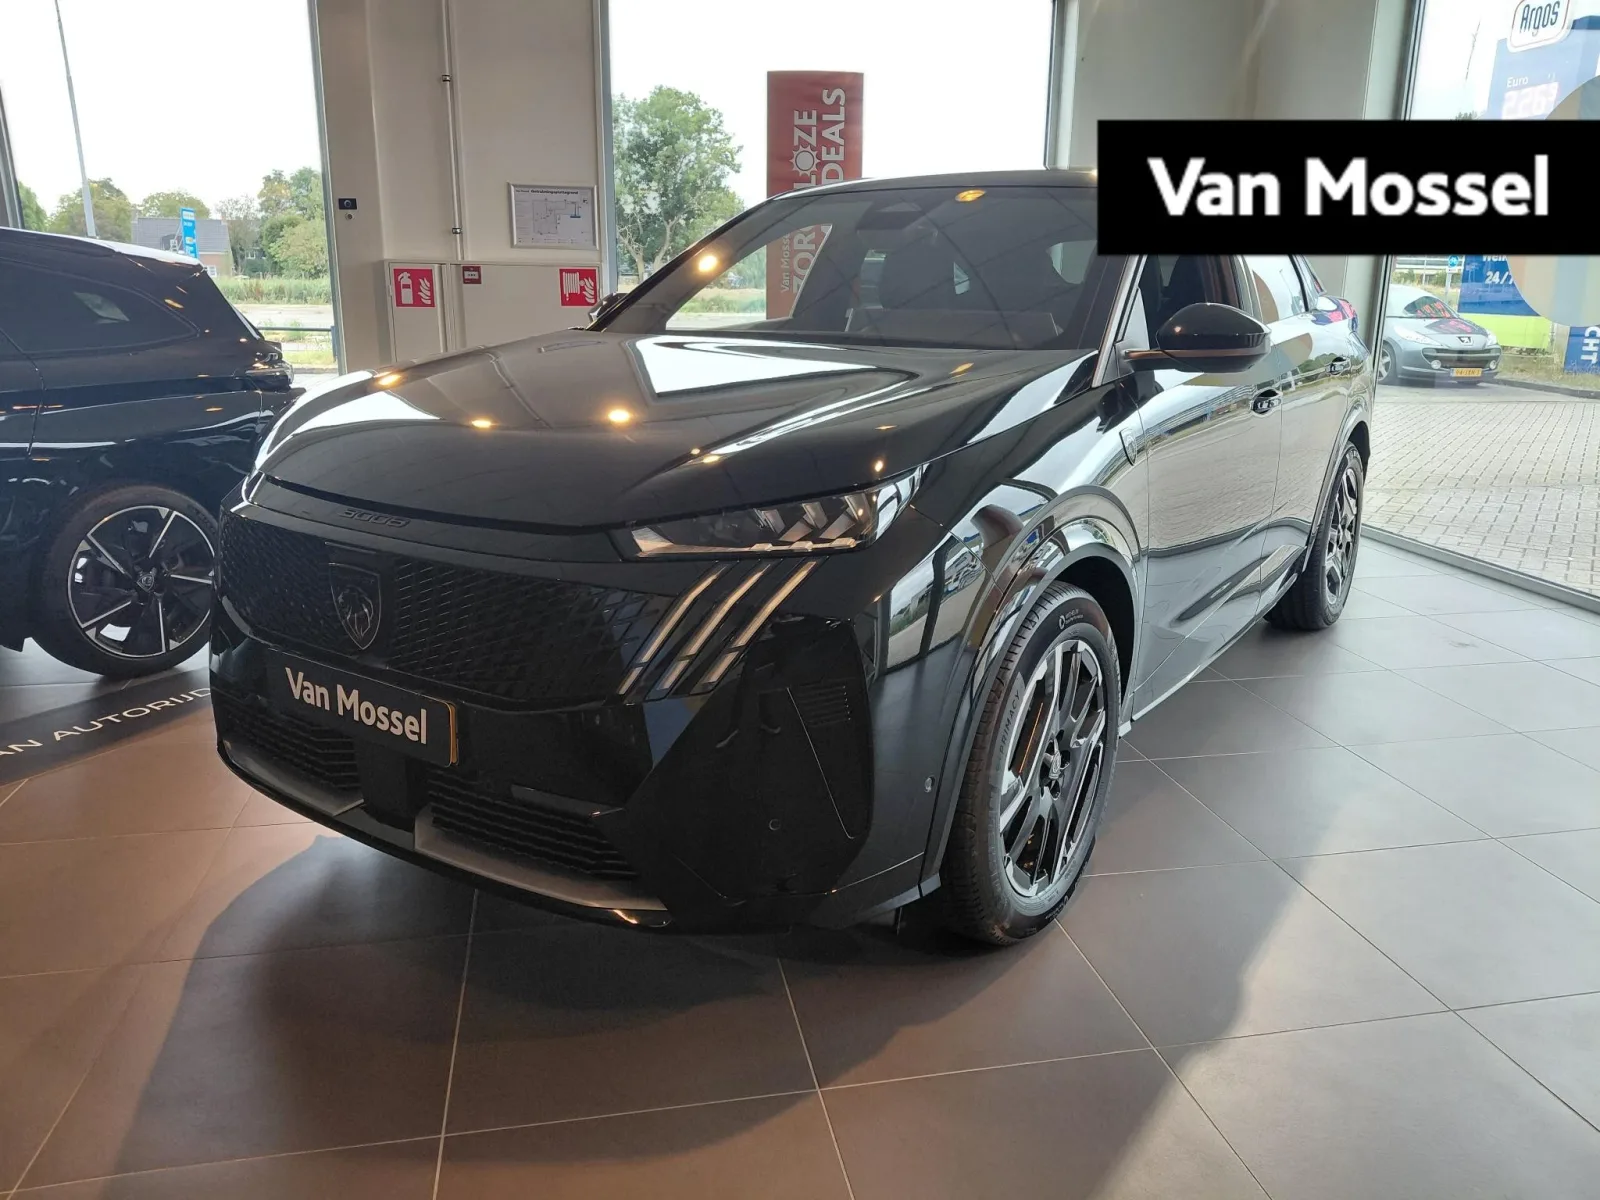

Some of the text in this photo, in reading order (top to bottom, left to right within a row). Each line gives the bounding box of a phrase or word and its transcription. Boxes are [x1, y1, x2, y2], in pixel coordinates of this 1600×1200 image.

[1519, 0, 1561, 37] Argos
[1506, 76, 1529, 88] Euro
[780, 233, 790, 294] Van Mosse
[285, 667, 427, 744] Van Mossel
